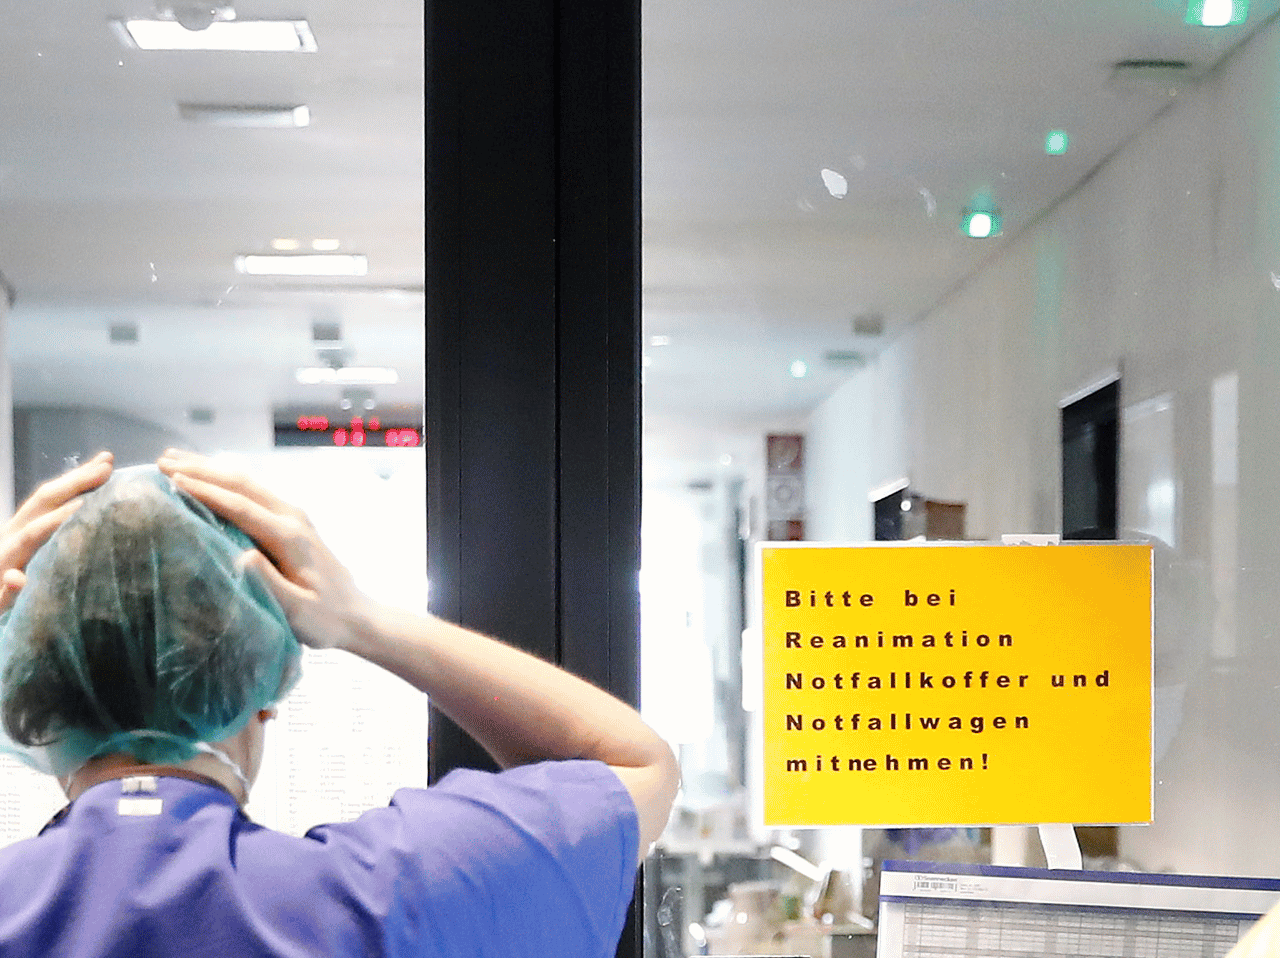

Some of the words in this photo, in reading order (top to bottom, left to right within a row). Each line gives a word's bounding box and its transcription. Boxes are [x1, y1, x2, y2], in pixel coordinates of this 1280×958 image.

[785, 590, 874, 608] Bitte
[904, 589, 956, 607] bei
[785, 630, 1013, 649] Reanimation
[785, 670, 1029, 690] Notfallkoffer
[1051, 669, 1110, 688] und
[785, 713, 1030, 734] Notfallwagen
[786, 753, 989, 772] mitnehmen!
